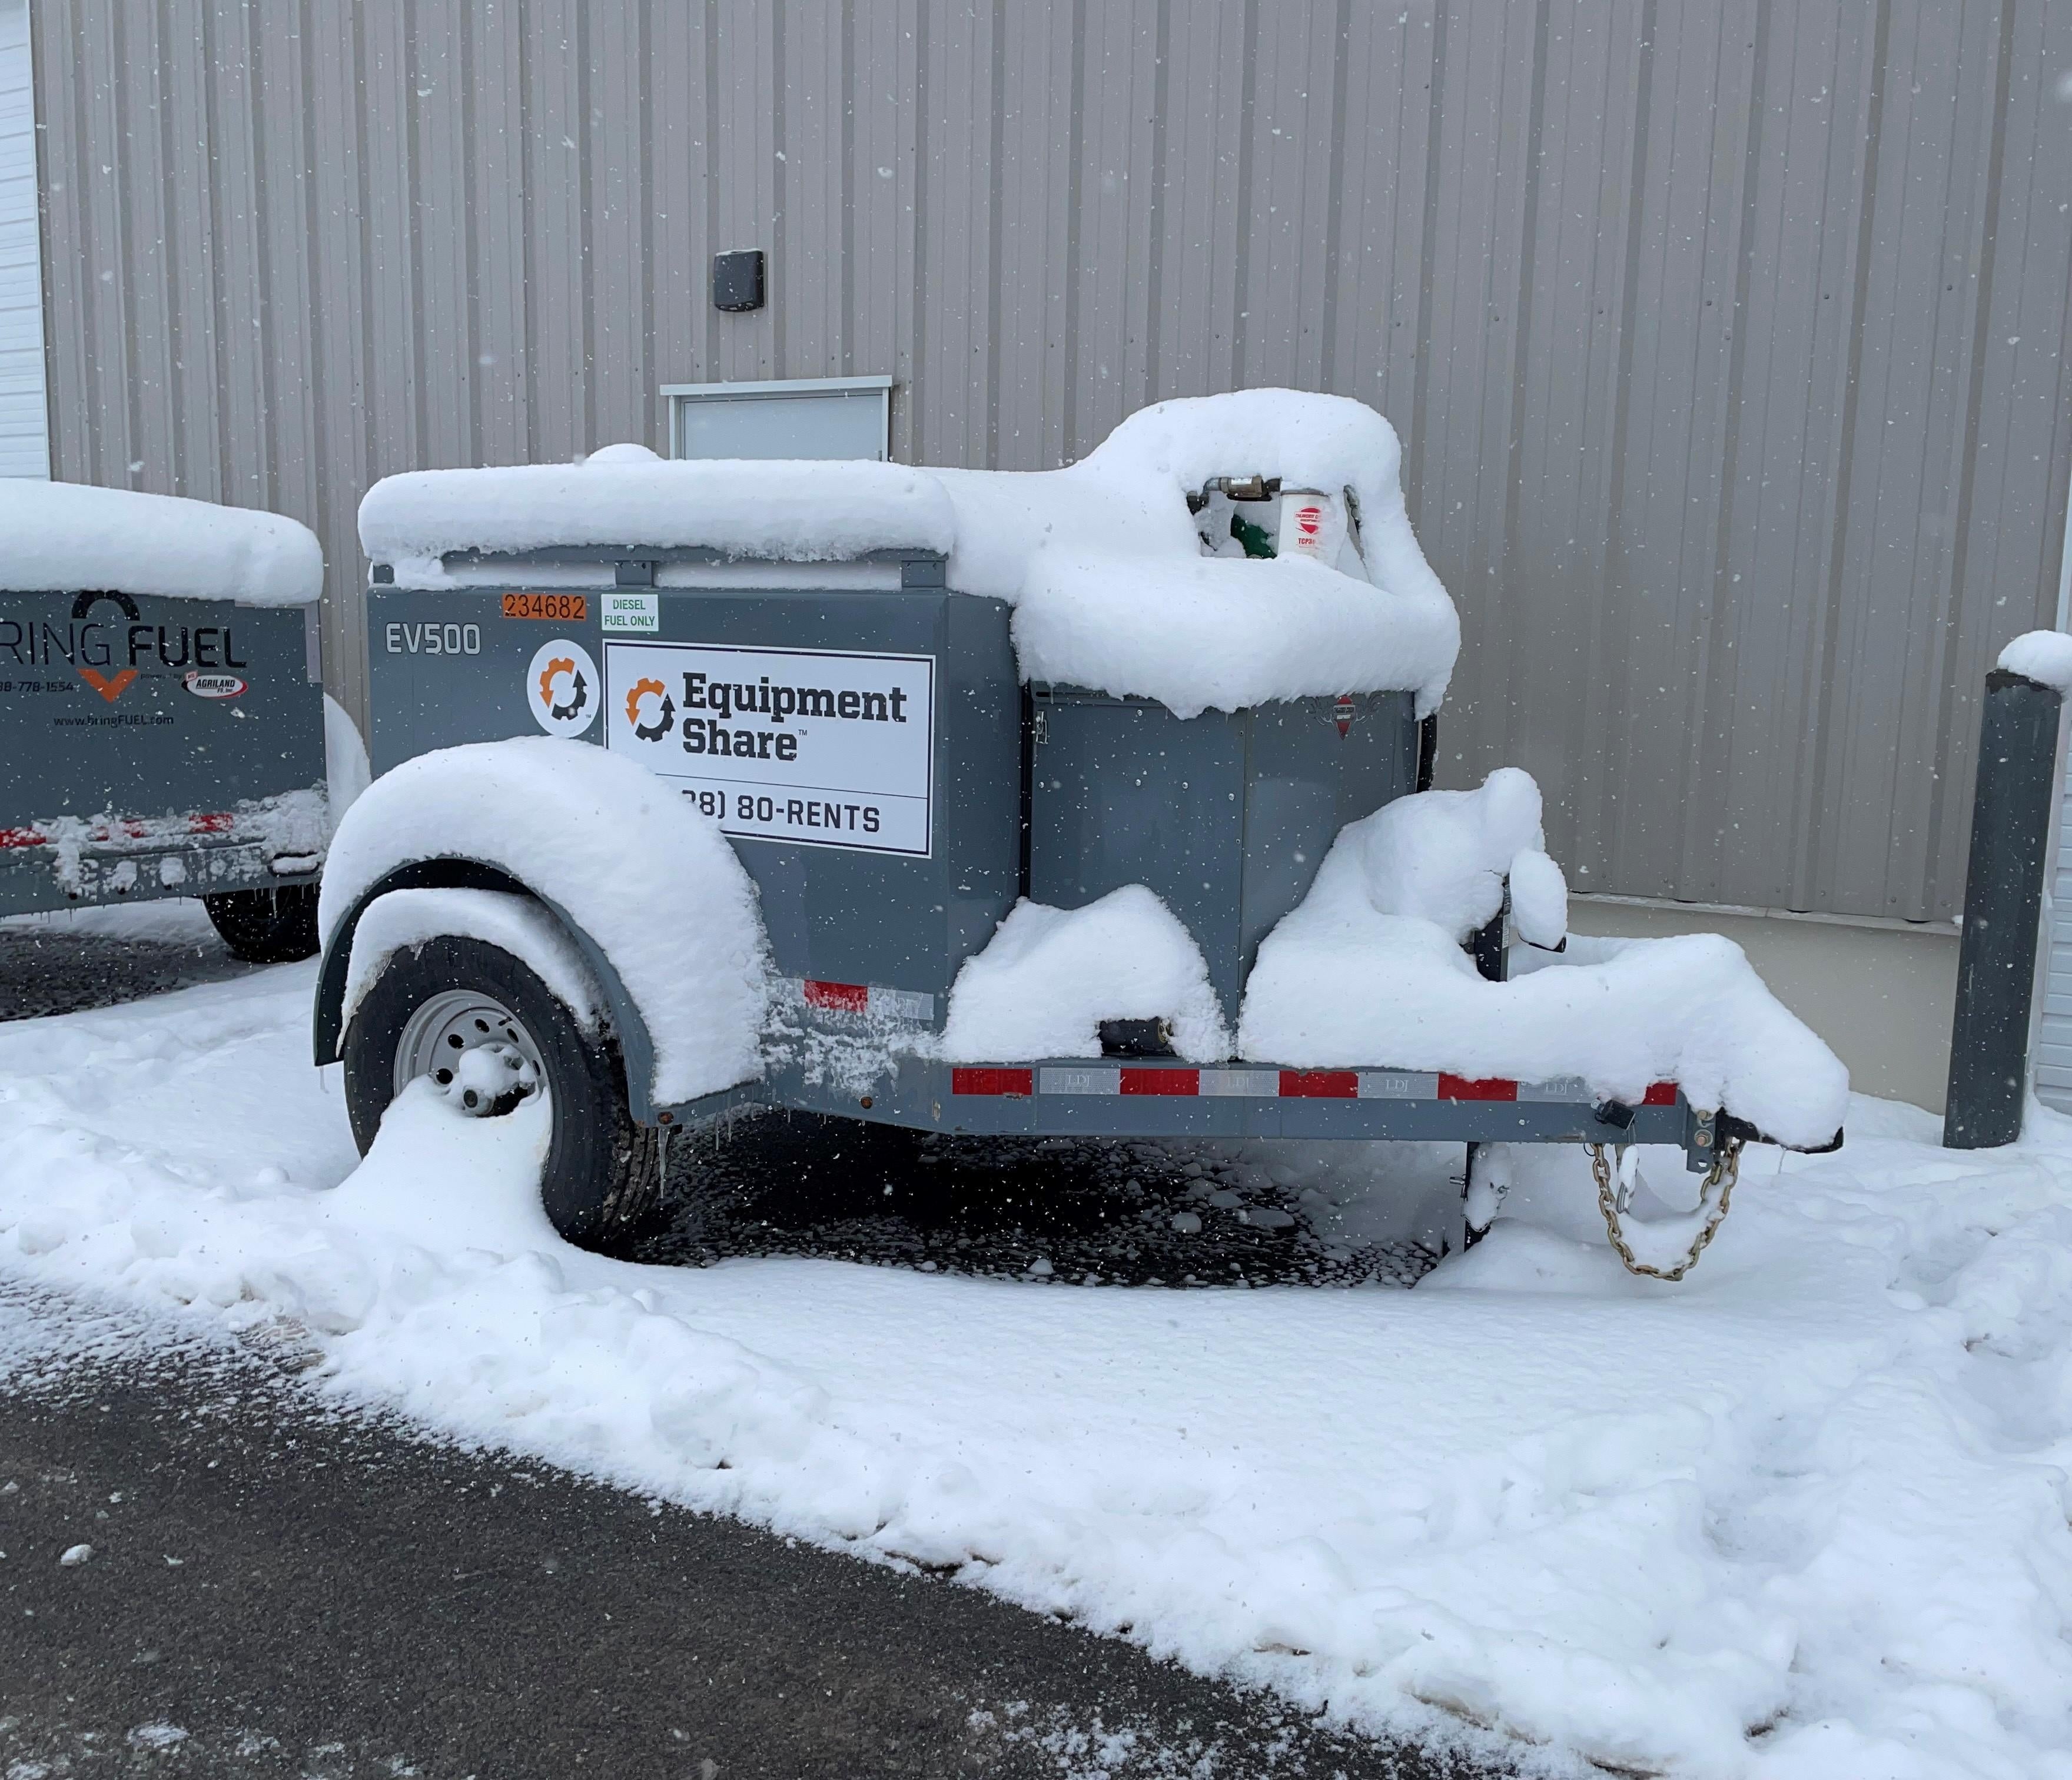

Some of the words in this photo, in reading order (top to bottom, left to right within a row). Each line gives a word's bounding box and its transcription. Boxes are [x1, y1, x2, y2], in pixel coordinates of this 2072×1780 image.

[504, 594, 585, 619] 234682
[613, 599, 646, 610] DIESEL
[605, 615, 628, 626] FUEL
[630, 616, 655, 626] ONLY
[128, 625, 247, 668] FUEL
[386, 622, 482, 655] EV500
[196, 679, 235, 688] AGRILAND
[683, 672, 907, 723] Equipment
[54, 715, 174, 729] www.bringFUEL.com
[683, 718, 797, 761] Share
[738, 795, 880, 832] 80-RENTS
